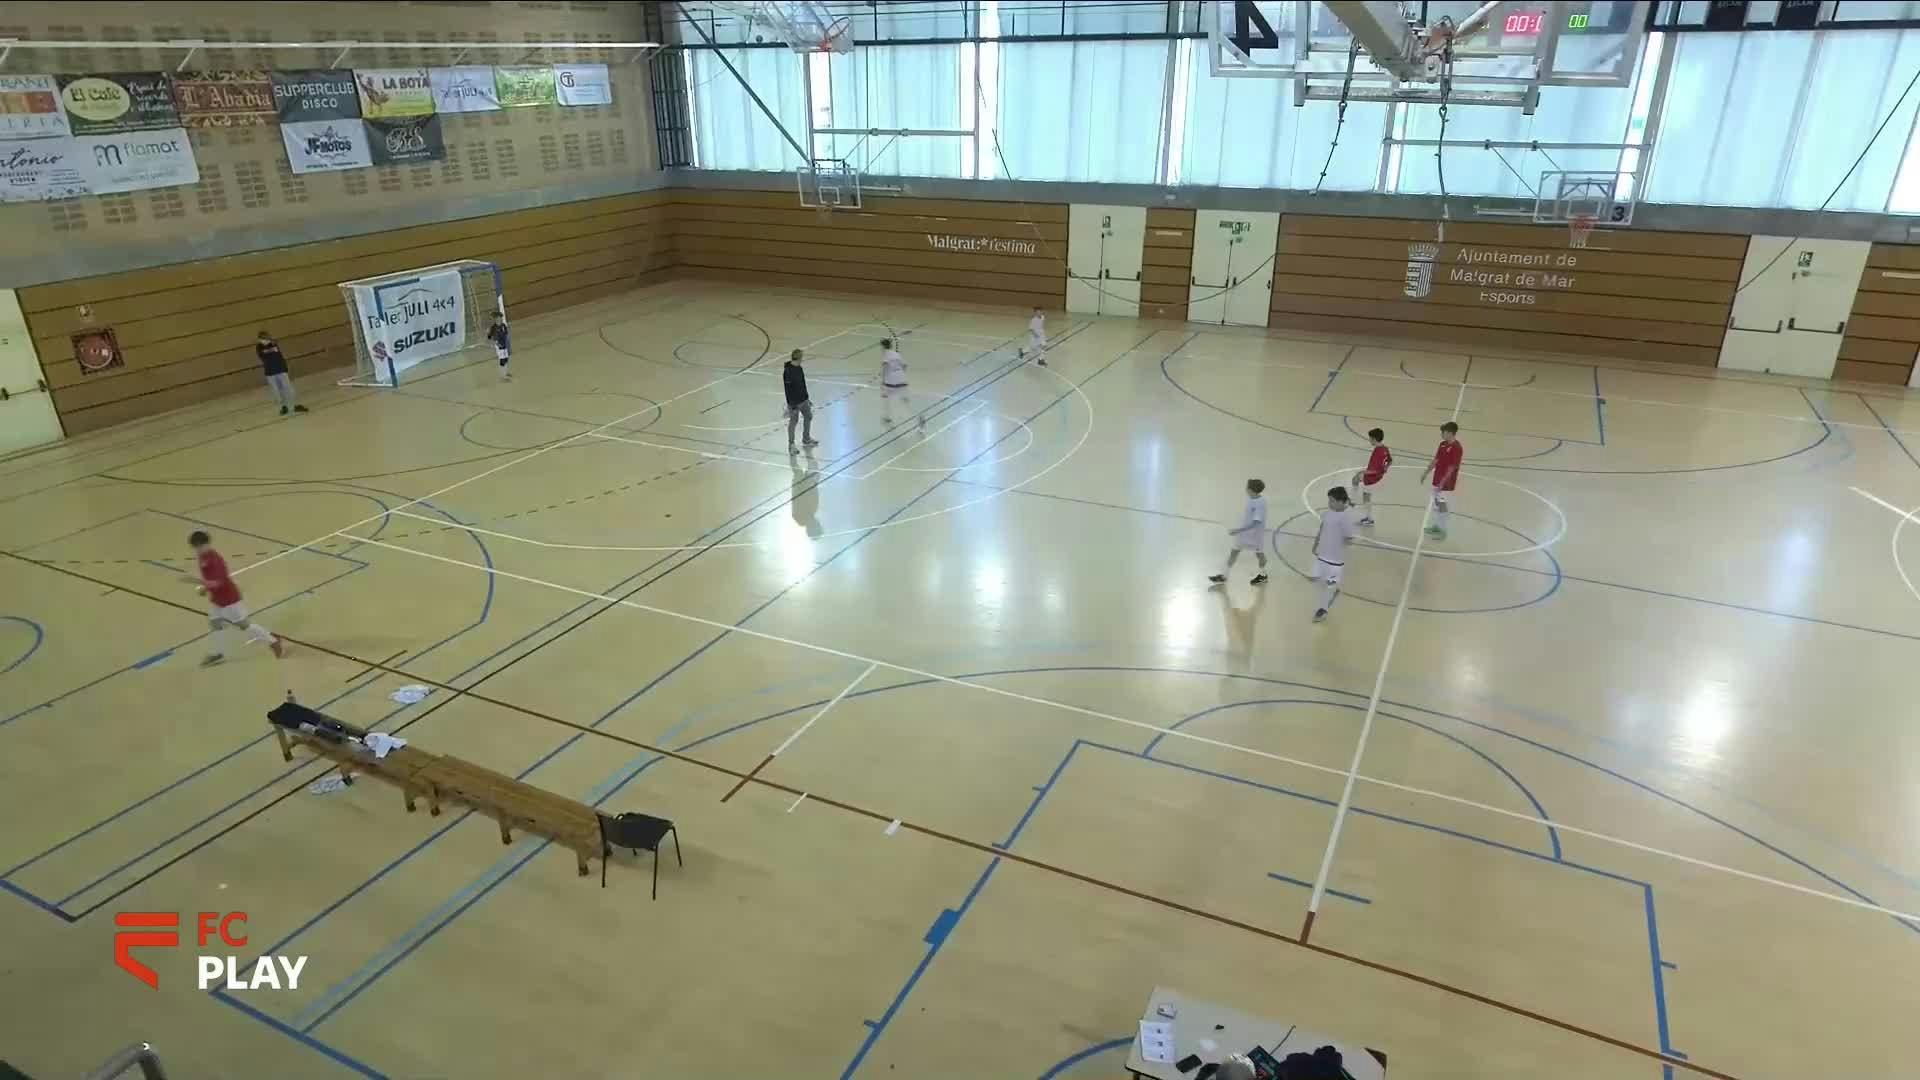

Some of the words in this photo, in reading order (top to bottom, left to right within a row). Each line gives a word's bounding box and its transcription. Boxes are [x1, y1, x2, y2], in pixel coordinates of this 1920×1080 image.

[1568, 14, 1590, 28] 00
[274, 82, 355, 97] SUPPERCLUB
[302, 98, 338, 109] DISCO
[1612, 206, 1625, 221] 3
[1456, 247, 1550, 264] Ajuntament
[1556, 254, 1577, 266] de
[1450, 268, 1510, 288] Malgrat
[1515, 273, 1536, 287] de
[1542, 274, 1577, 288] Mar
[432, 296, 456, 312] 4x4
[1479, 291, 1536, 305] Esports
[393, 321, 457, 354] SUZUKI
